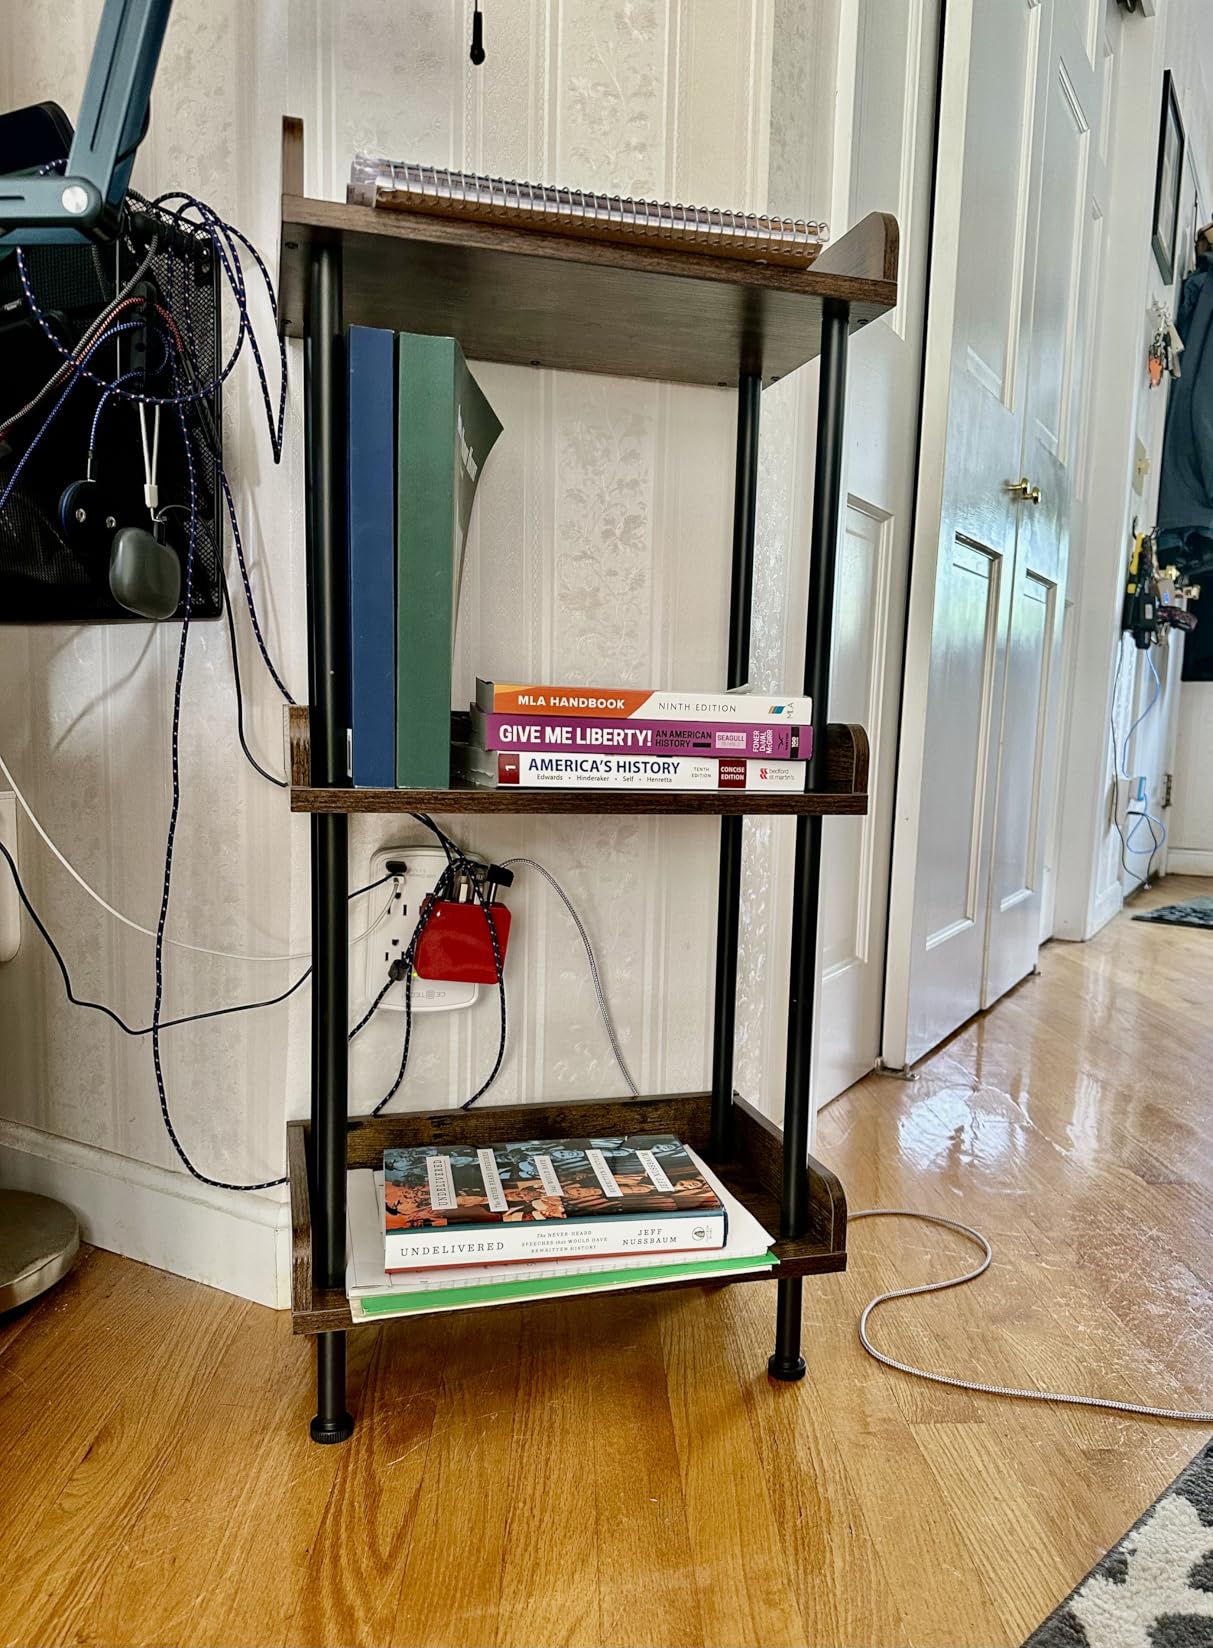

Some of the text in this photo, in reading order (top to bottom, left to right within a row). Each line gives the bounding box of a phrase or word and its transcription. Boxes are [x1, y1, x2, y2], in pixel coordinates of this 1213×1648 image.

[518, 695, 625, 710] MLA HANDBOOK
[658, 702, 737, 713] NINTH EDITION
[786, 702, 794, 719] MLA
[499, 724, 652, 747] GIVE ME LIBERTY!
[655, 730, 712, 740] AN AMERICAN
[717, 734, 745, 742] SEAGULL
[655, 739, 691, 748] HISTORY
[752, 730, 760, 753] FONER
[528, 758, 680, 775] AMERICA'S HISTORY
[720, 765, 745, 773] CONCISE
[720, 773, 745, 781] EDITION
[433, 1159, 448, 1206] UNDELIVERED
[637, 1228, 663, 1237] JEFF
[622, 1236, 678, 1246] NUSSBAUM
[400, 1242, 505, 1257] UNDELIVERED
